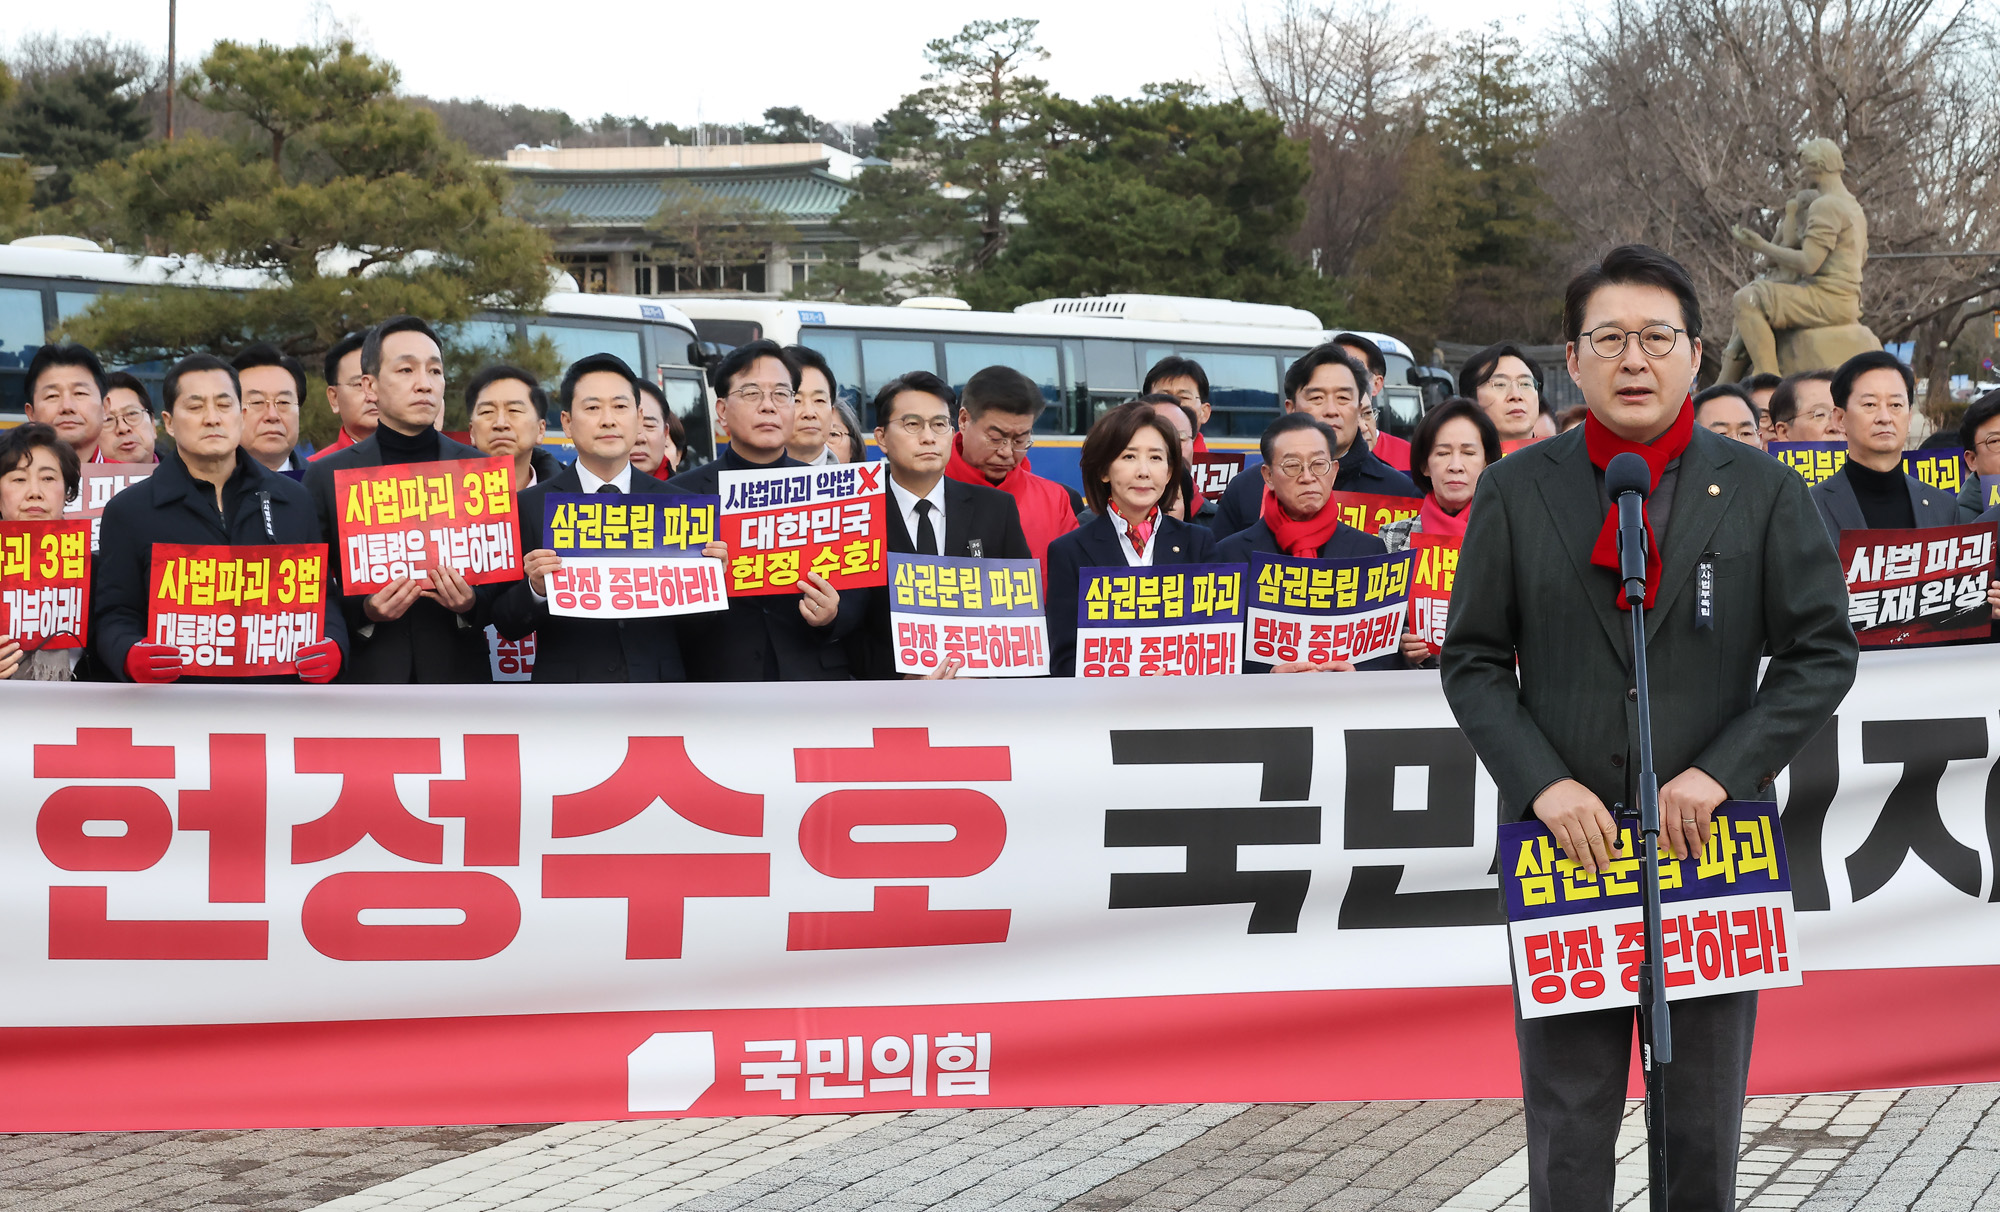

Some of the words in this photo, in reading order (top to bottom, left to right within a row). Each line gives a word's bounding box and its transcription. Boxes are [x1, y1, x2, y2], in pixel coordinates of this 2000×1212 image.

[345, 473, 456, 526] 사법파괴
[462, 467, 511, 516] 3법
[725, 475, 811, 510] 사법파괴
[816, 468, 855, 498] 악법
[550, 502, 655, 549] 삼권분립
[662, 503, 715, 550] 파괴
[740, 501, 871, 550] 대한민국
[40, 531, 85, 579] 3법
[347, 529, 427, 584] 대통령은
[429, 521, 515, 577] 거부하라!
[731, 550, 800, 591] 헌정
[810, 538, 881, 580] 수호!
[1847, 542, 1923, 584] 사법
[1924, 531, 1994, 576] 파괴
[157, 557, 271, 607] 사법파괴
[277, 556, 321, 604] 3법
[552, 566, 601, 611] 당장
[608, 565, 720, 611] 중단하라!
[894, 562, 983, 610] 삼권분립
[988, 567, 1039, 610] 파괴
[1085, 573, 1185, 620] 삼권분립
[1191, 572, 1241, 617] 파괴
[1256, 563, 1360, 609] 삼권분립
[1364, 557, 1411, 603] 파괴
[1848, 584, 1917, 631] 독재
[1918, 570, 1989, 618] 완성
[2, 586, 83, 640] 거부하라!
[155, 612, 236, 667] 대통령은
[1253, 617, 1302, 662] 당장
[1308, 611, 1401, 665] 중단하라!
[898, 622, 938, 668] 당장
[944, 624, 1044, 669] 중단하라!
[1083, 636, 1132, 678] 당장
[1139, 632, 1236, 677] 중단하라!
[33, 727, 1012, 962] 헌정수호
[1696, 815, 1780, 884] 파괴
[1524, 925, 1605, 1005] 당장
[1614, 906, 1790, 993] 중단하라!
[740, 1031, 992, 1101] 국민의힘
